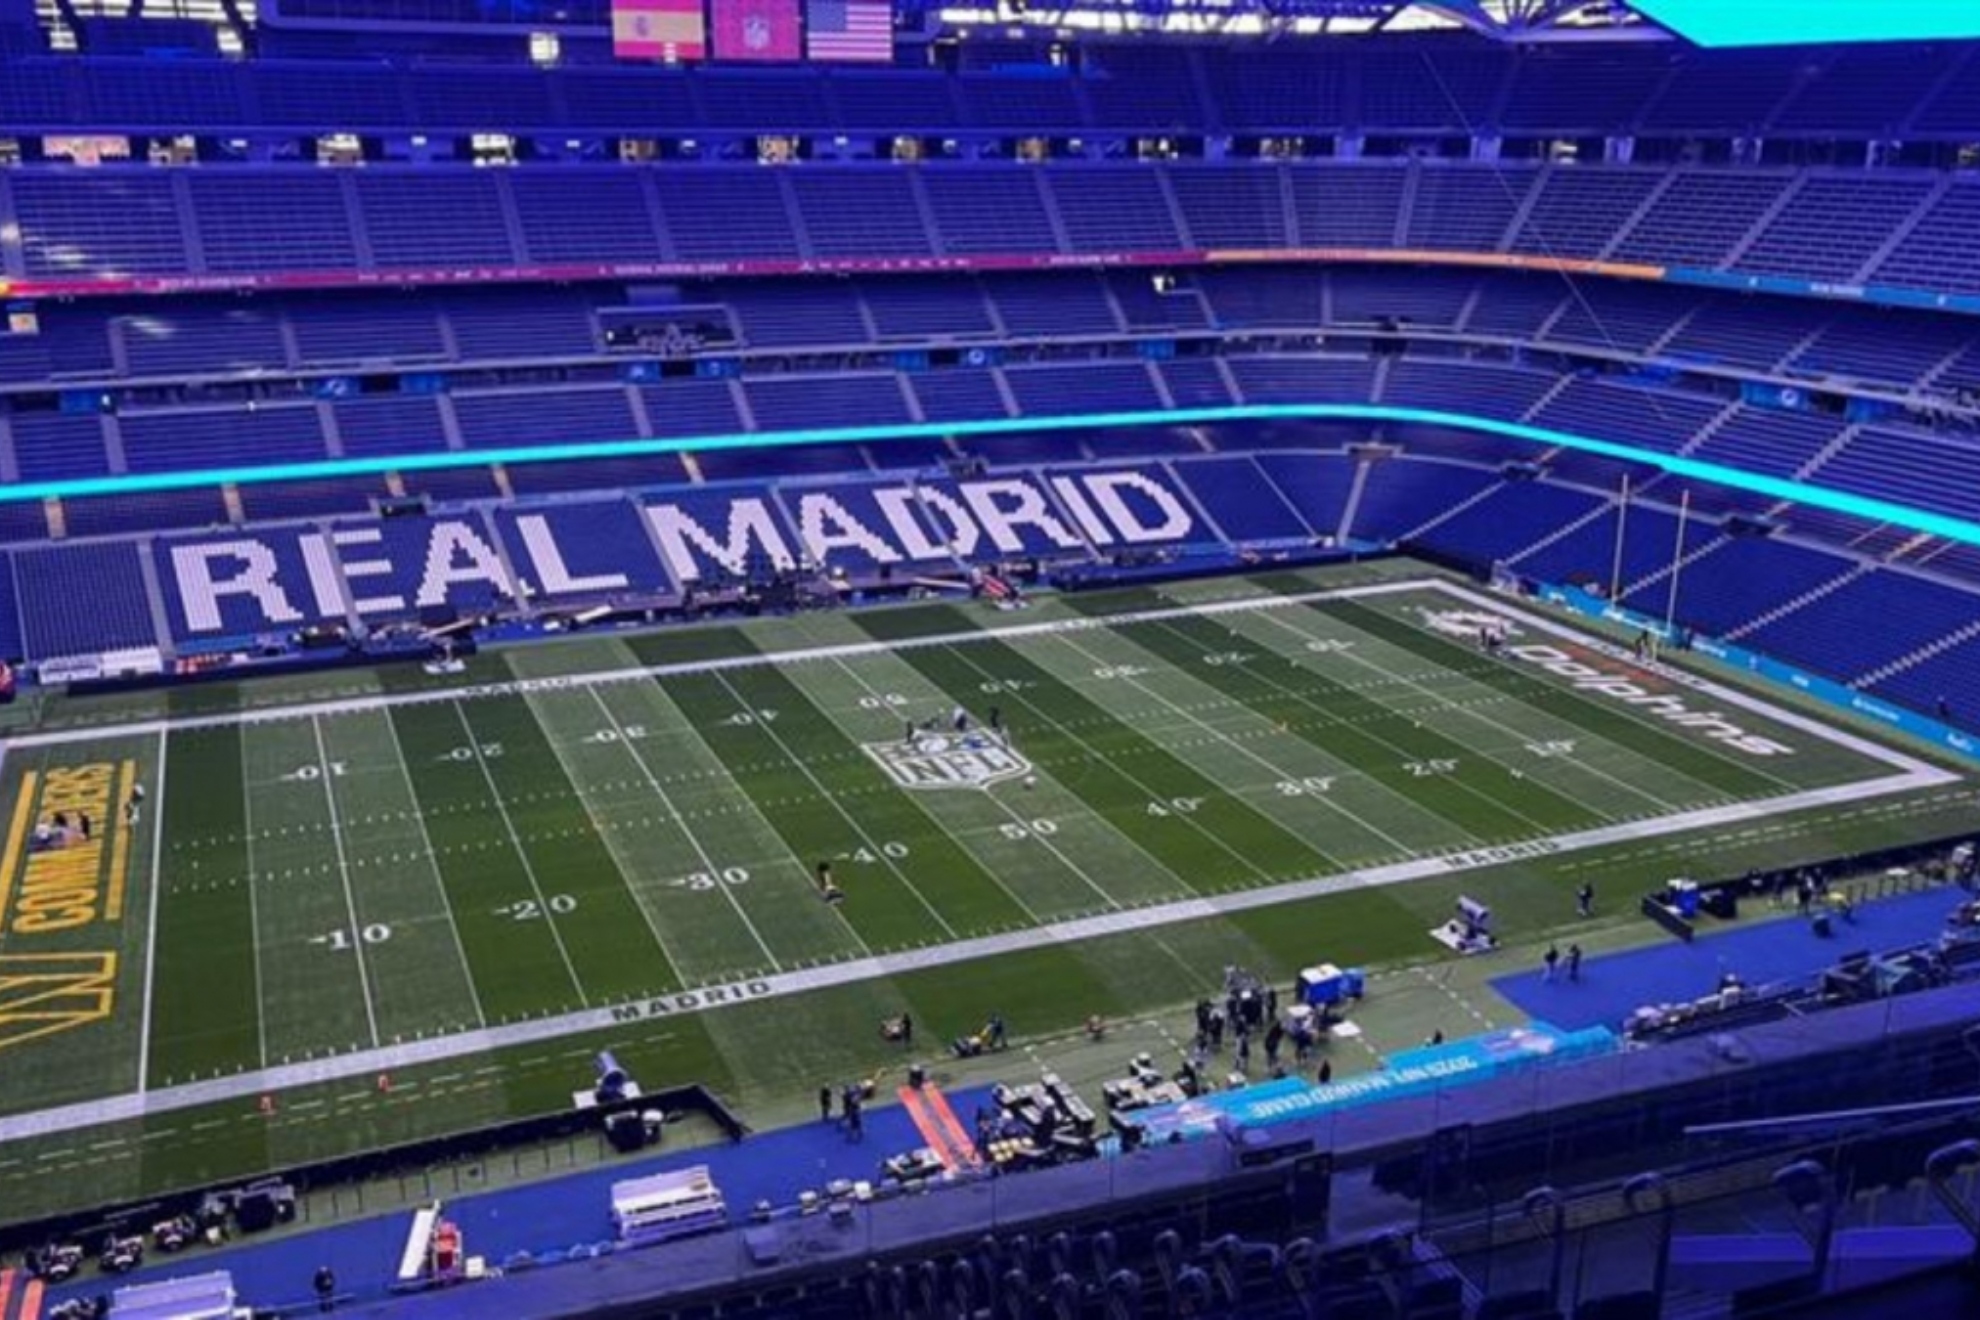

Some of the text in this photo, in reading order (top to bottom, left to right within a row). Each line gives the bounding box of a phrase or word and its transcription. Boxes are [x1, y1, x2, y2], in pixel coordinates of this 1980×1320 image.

[171, 472, 1192, 631] REAL MADRID
[893, 748, 1024, 786] NFL
[12, 762, 115, 933] COMMDERS
[686, 866, 750, 891] 30
[512, 893, 577, 920] 20
[329, 922, 391, 950] 10
[610, 980, 771, 1022] MADRID
